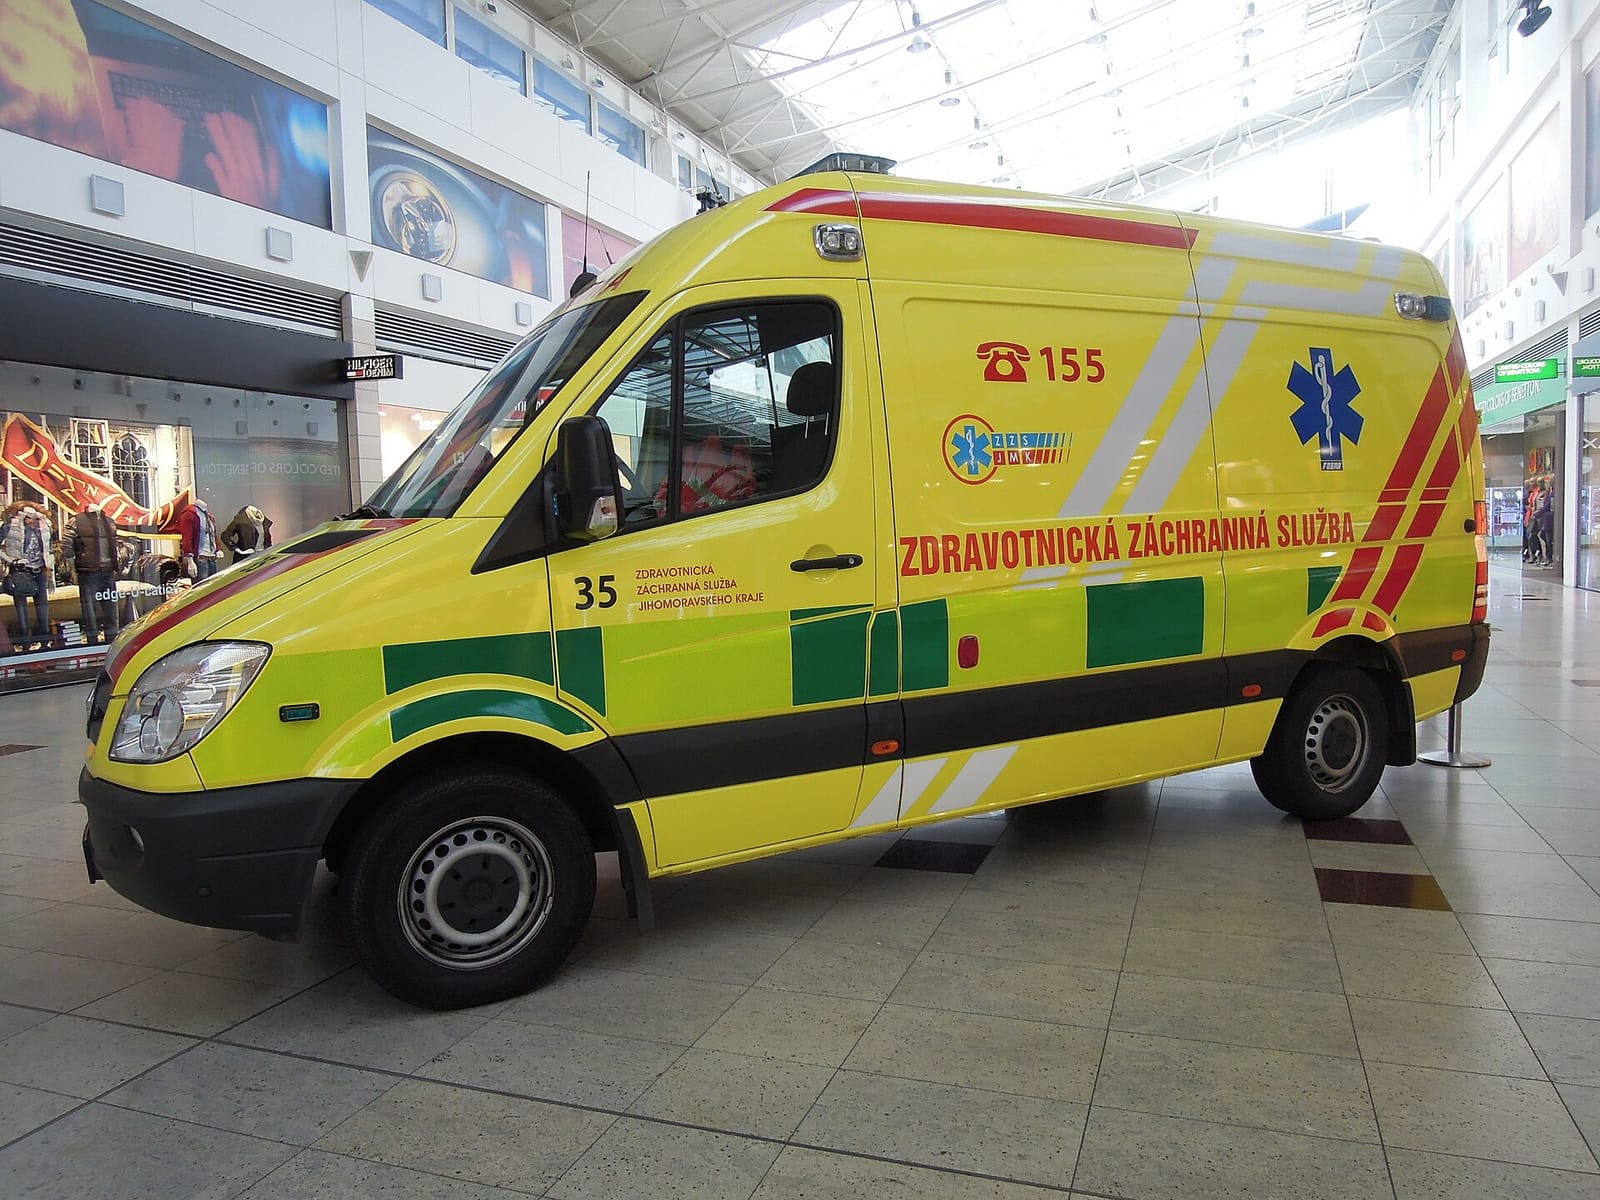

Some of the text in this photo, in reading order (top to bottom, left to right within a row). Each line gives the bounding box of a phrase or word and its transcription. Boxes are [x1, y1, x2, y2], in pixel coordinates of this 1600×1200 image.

[347, 357, 393, 370] HILFIGER
[1039, 346, 1106, 384] 155
[366, 368, 394, 377] DENIM
[994, 435, 1029, 447] ZZS
[997, 451, 1032, 463] JMK
[899, 507, 1355, 577] ZDRAVOTNICKÁ ZÁCHRANNÁ SLUŽBA
[635, 563, 715, 580] ZDRAVOTNICKÁ
[574, 575, 618, 611] 35
[636, 577, 738, 595] ZÁCHRANNÁ SLUŽBA
[638, 592, 764, 611] JIHOMORAVSKÉHO KRAJE
